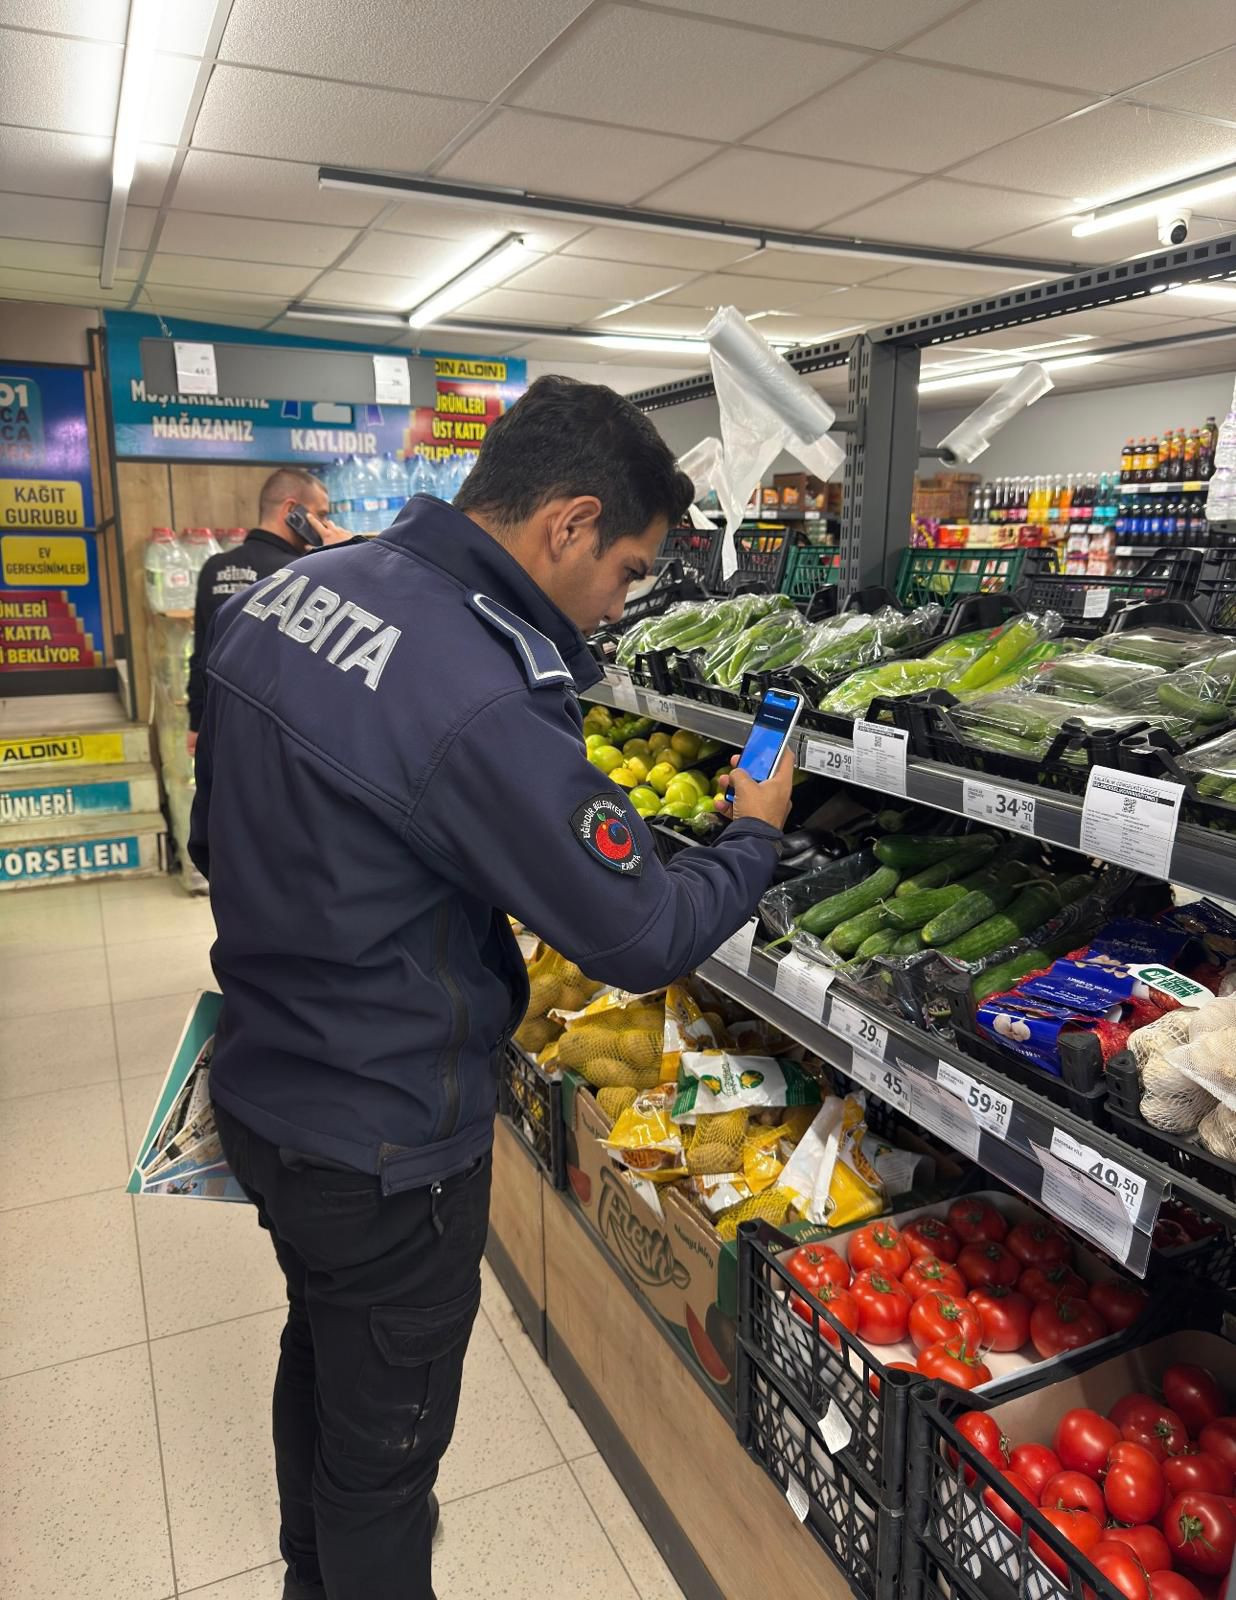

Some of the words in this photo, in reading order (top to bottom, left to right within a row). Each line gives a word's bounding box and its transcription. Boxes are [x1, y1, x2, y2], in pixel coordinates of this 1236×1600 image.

[457, 362, 497, 377] ALDIN
[152, 412, 254, 442] MAĞAZAMIZ
[432, 416, 453, 438] ÜST
[454, 421, 487, 440] KATTA
[291, 429, 377, 455] KATLIDIR
[14, 485, 66, 504] KAĞIT
[5, 508, 78, 525] GURUBU
[38, 547, 51, 559] EV
[6, 560, 86, 576] GEREKSİNİMLERİ
[4, 625, 52, 642] KATTA
[242, 567, 402, 692] ZABITA
[8, 645, 80, 664] BEKLİYOR
[3, 742, 68, 763] ALDIN
[0, 788, 75, 819] ÜNLERİ
[1023, 812, 1033, 823] TL
[0, 842, 129, 877] ORSELEN
[858, 1019, 877, 1042] 29
[883, 1071, 903, 1095] 45
[996, 1113, 1004, 1125] TL
[1125, 1192, 1136, 1207] TL
